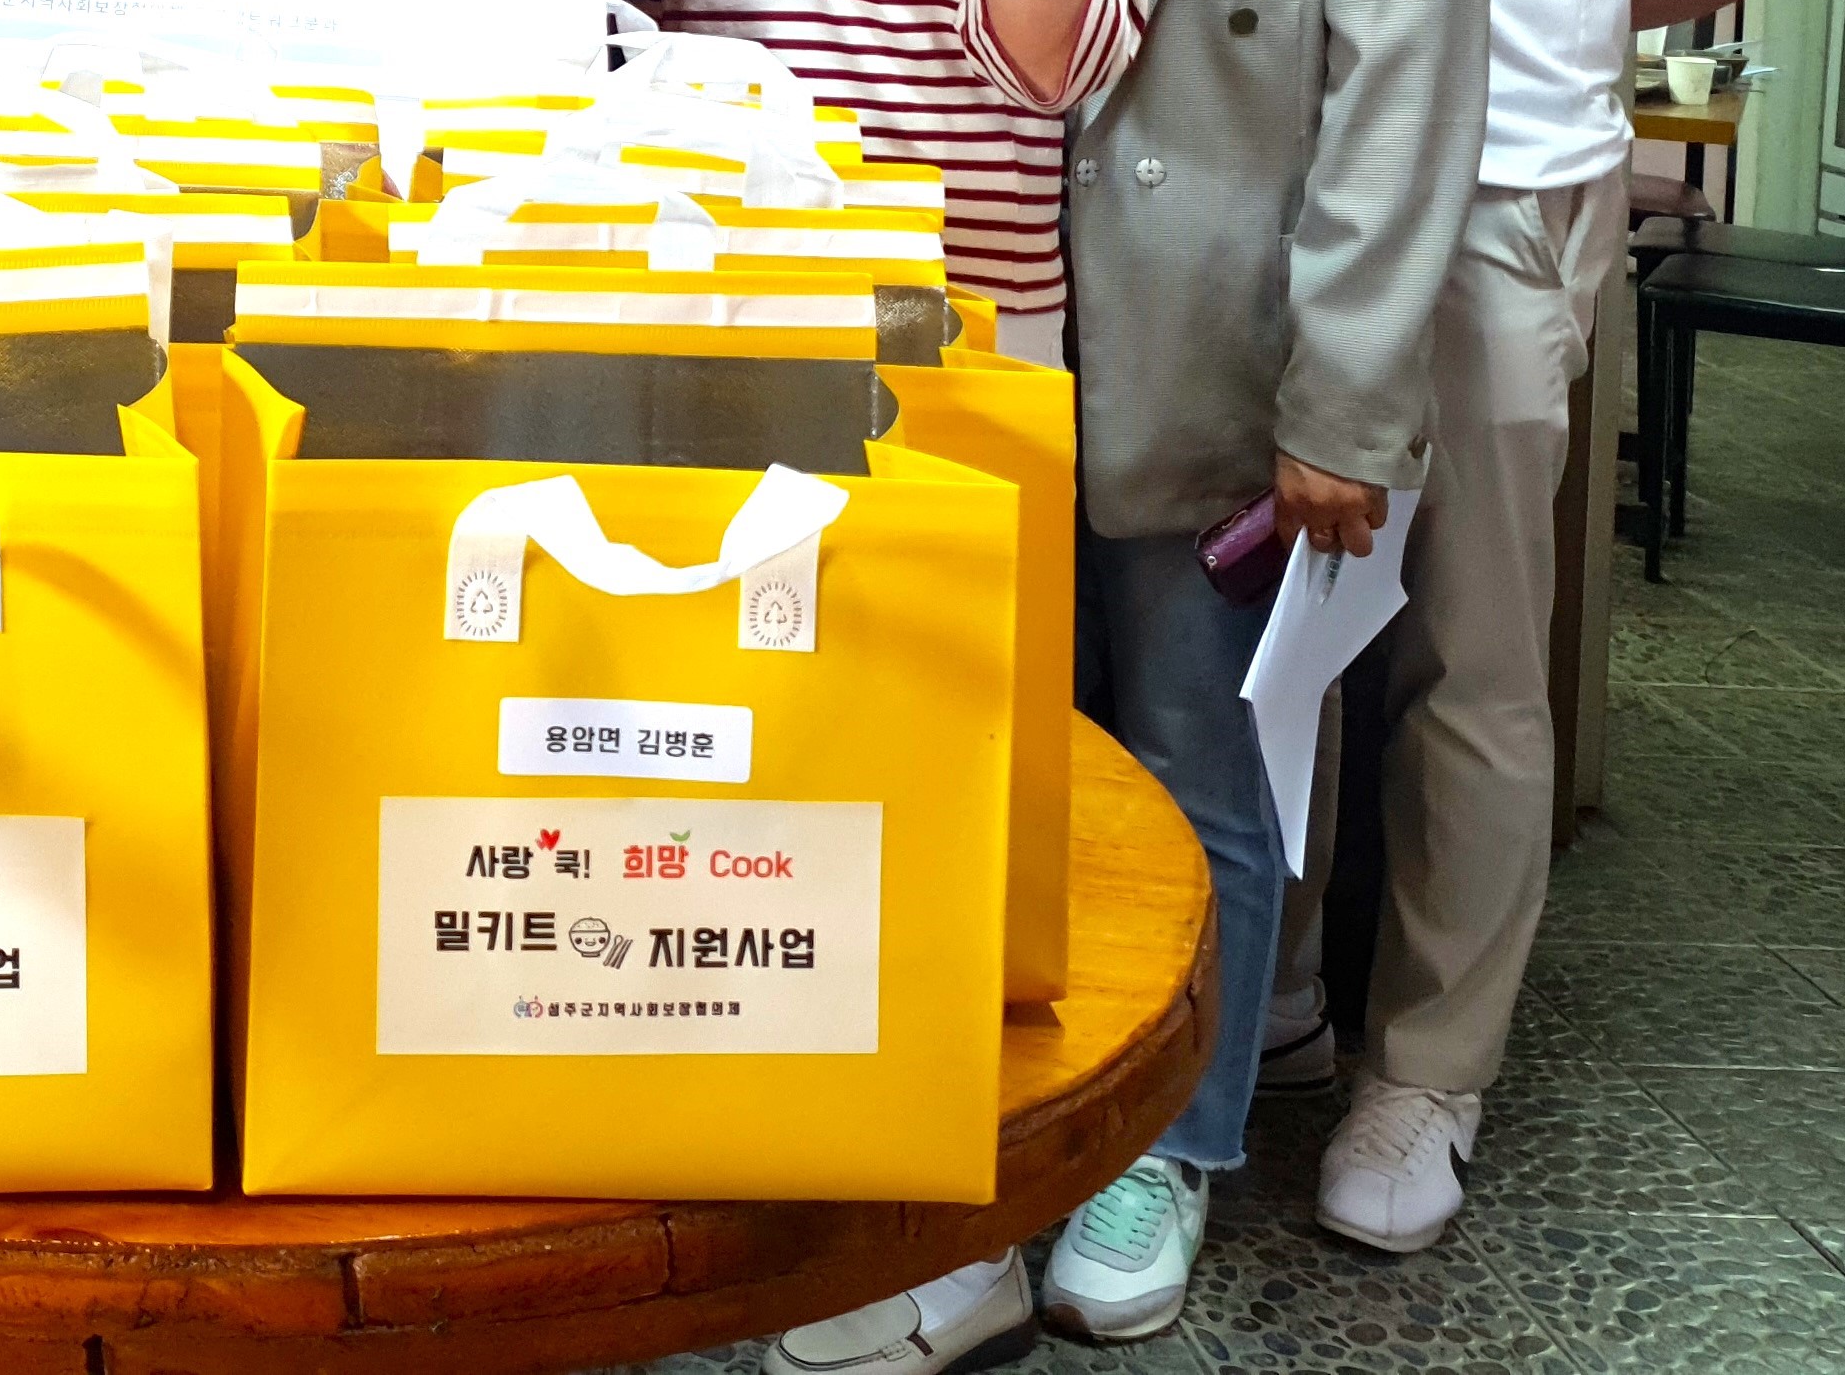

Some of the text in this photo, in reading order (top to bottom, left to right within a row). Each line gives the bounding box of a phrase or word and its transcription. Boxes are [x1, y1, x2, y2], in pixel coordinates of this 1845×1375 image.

[545, 725, 715, 759] 용암면 김병훈
[466, 844, 793, 879] 사랑 쿡! 희망 Cook
[434, 909, 816, 970] 밀키트 지원사업
